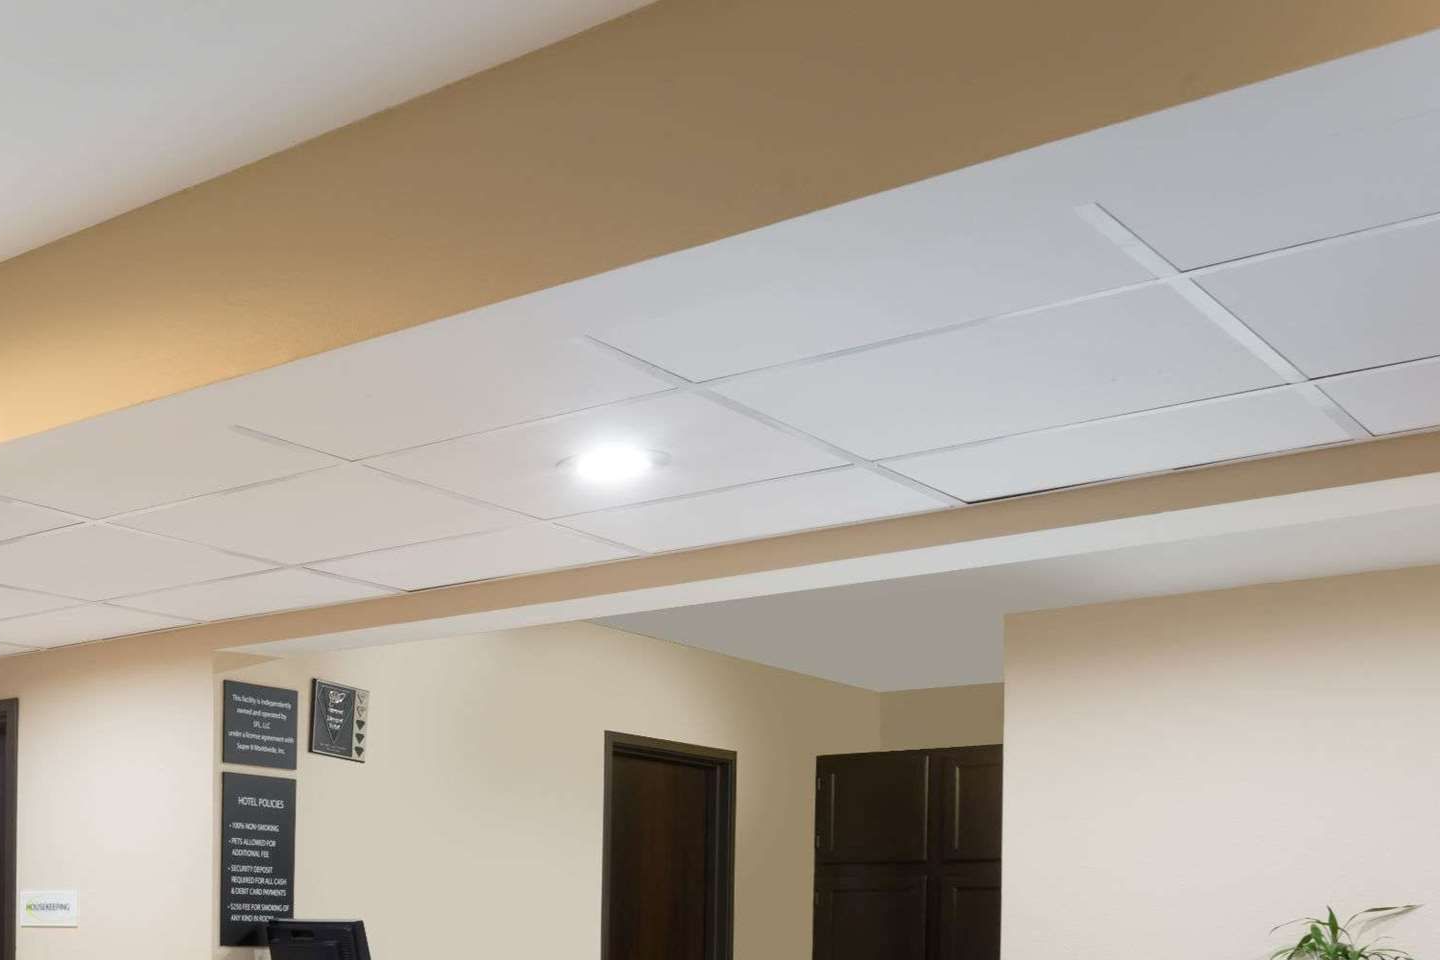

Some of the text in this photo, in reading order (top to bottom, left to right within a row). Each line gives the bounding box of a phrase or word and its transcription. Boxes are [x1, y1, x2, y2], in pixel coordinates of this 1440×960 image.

[238, 796, 284, 809] HOTEL POLICIES
[231, 837, 242, 845] PETS
[243, 838, 265, 847] ALLOWED
[232, 848, 270, 858] ADDITIONAL FEE
[231, 864, 272, 874] SECURITY DEPOSIT
[231, 876, 254, 884] REQUIRED
[235, 887, 249, 895] DEBIT
